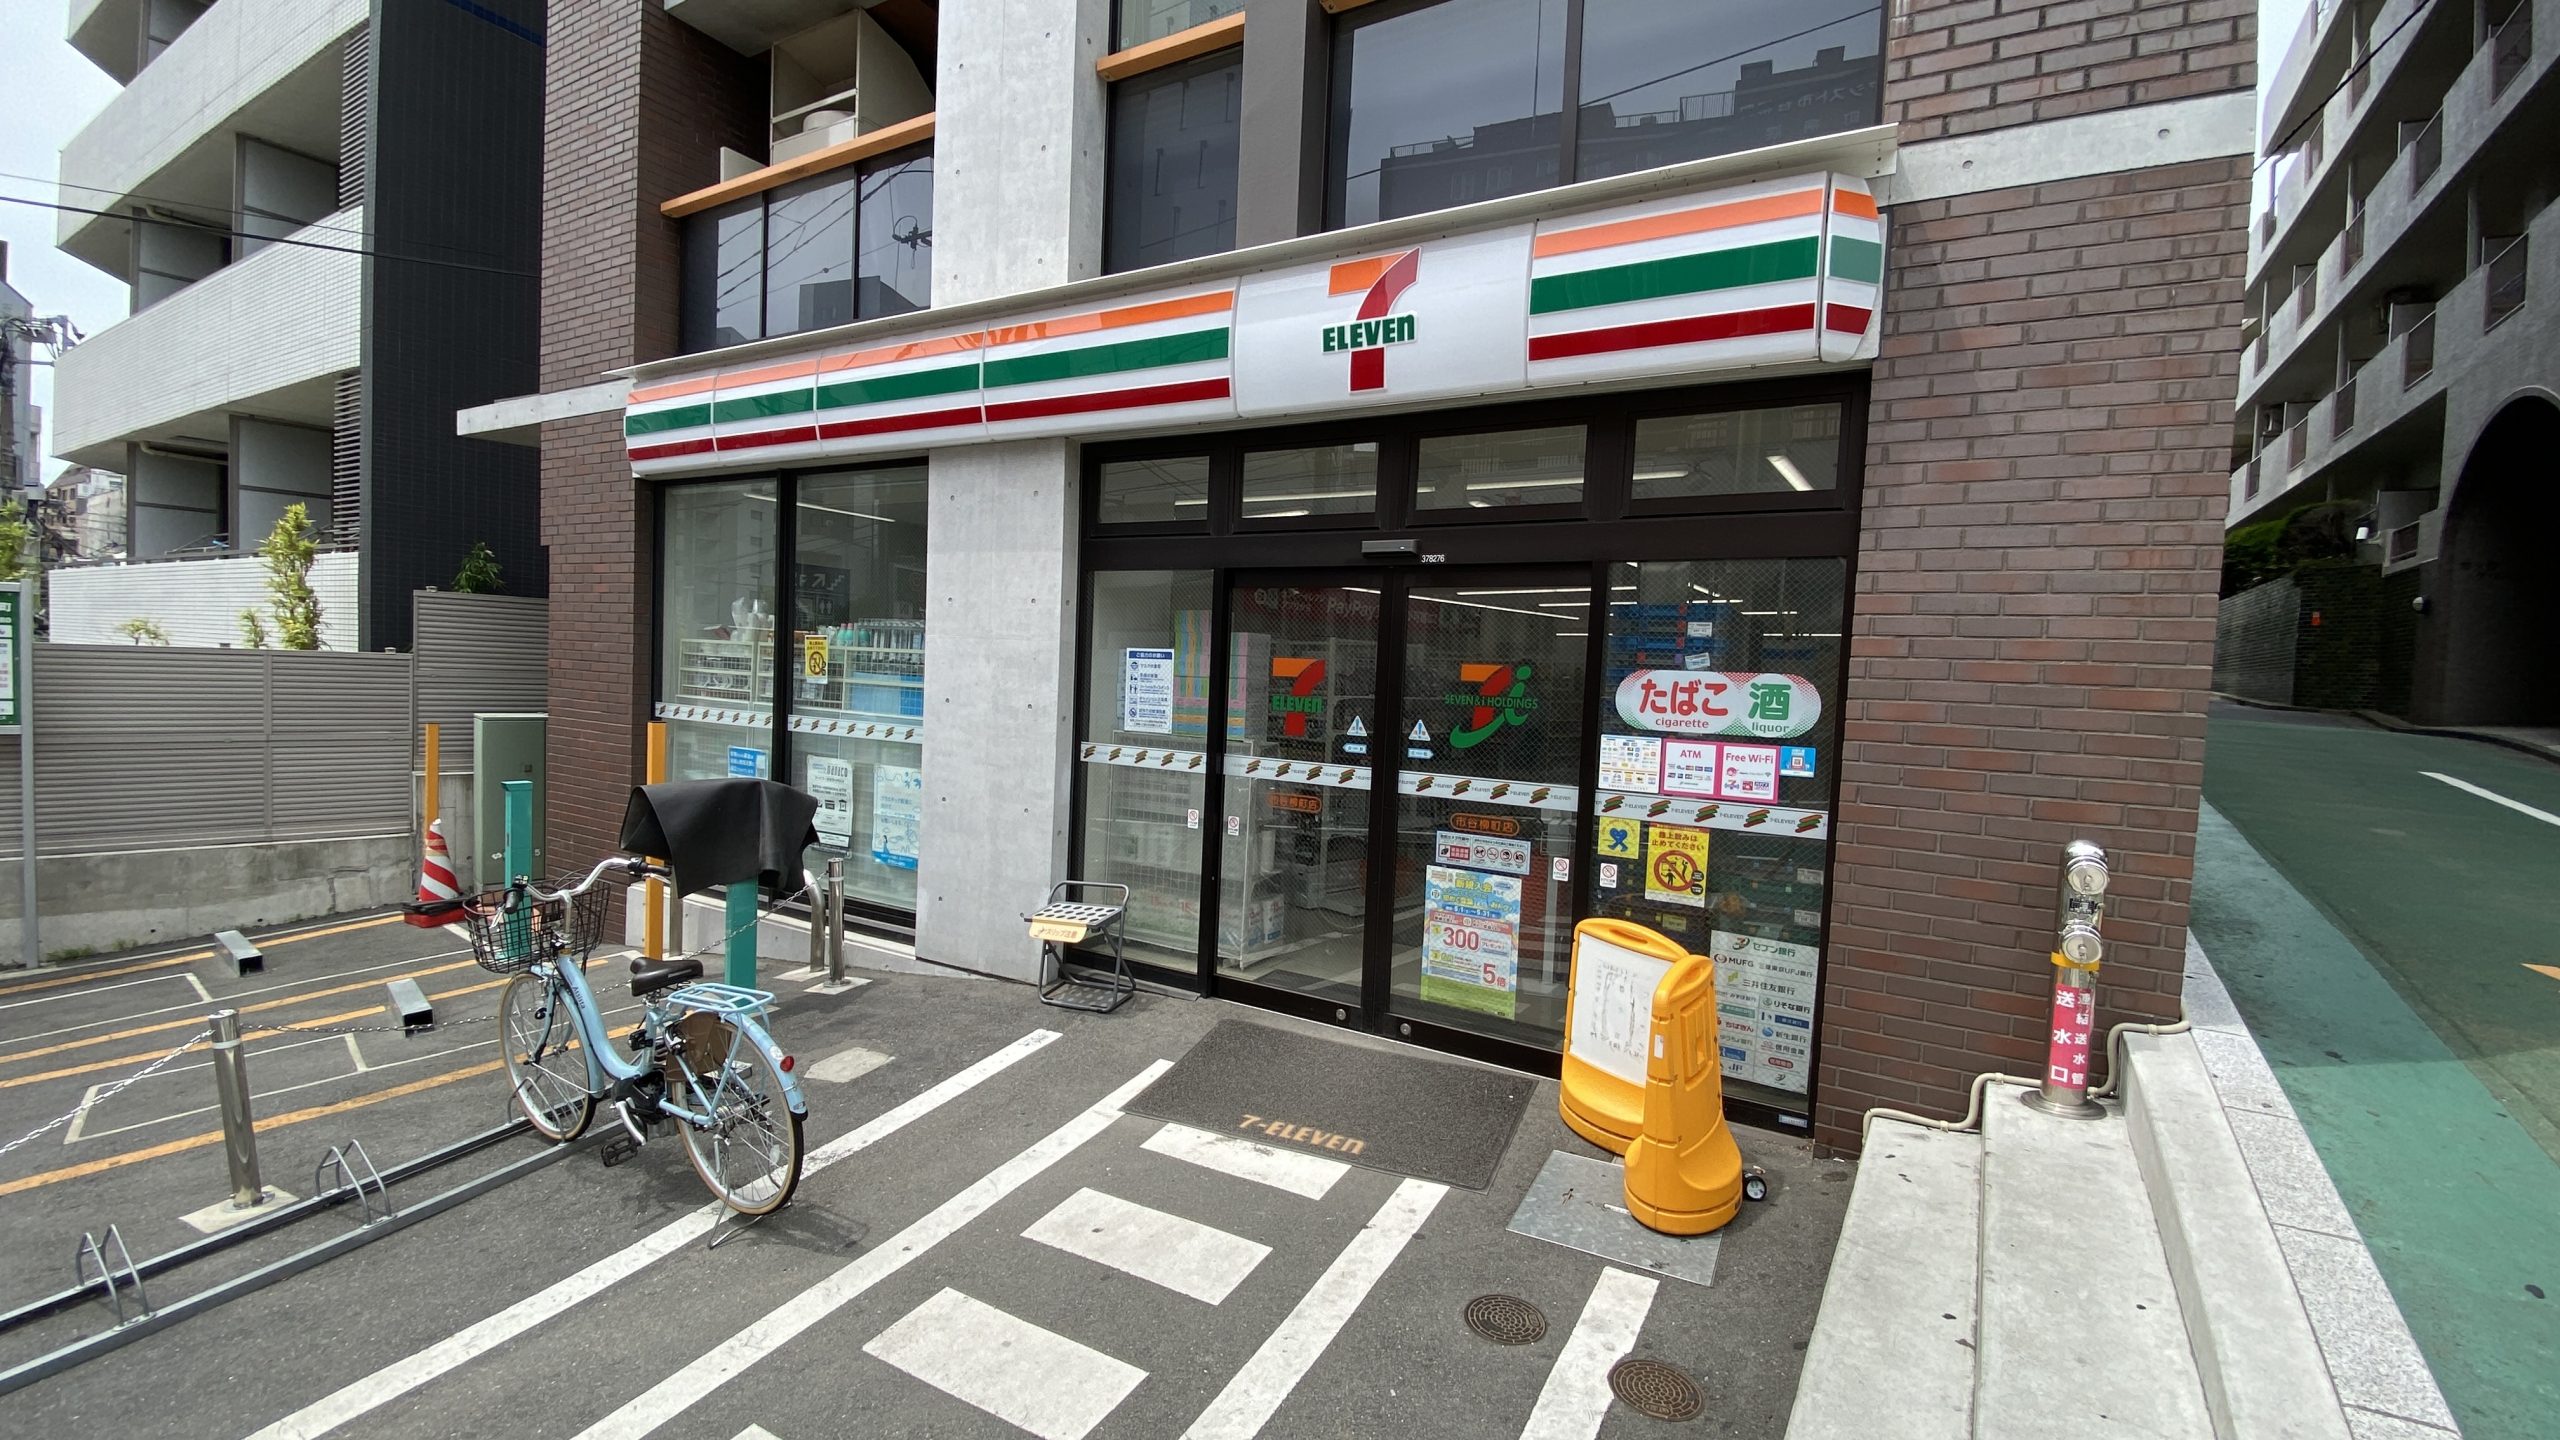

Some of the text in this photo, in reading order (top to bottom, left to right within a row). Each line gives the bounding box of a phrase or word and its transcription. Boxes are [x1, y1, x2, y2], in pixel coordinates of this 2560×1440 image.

[1422, 555, 1445, 563] 378276
[1639, 678, 1792, 721] たばこ 酒
[1655, 717, 1709, 729] cigarette
[1751, 721, 1790, 734] liquor
[1680, 750, 1702, 759] ATM
[1725, 752, 1774, 764] Free Wi-Fi
[1443, 927, 1479, 951] 300
[1752, 942, 1797, 958] セブン銀行
[1728, 956, 1754, 968] MUFG
[1742, 979, 1796, 996] 三井住友銀行
[1773, 1001, 1811, 1015] りそな銀行
[2050, 989, 2076, 1083] 送水口
